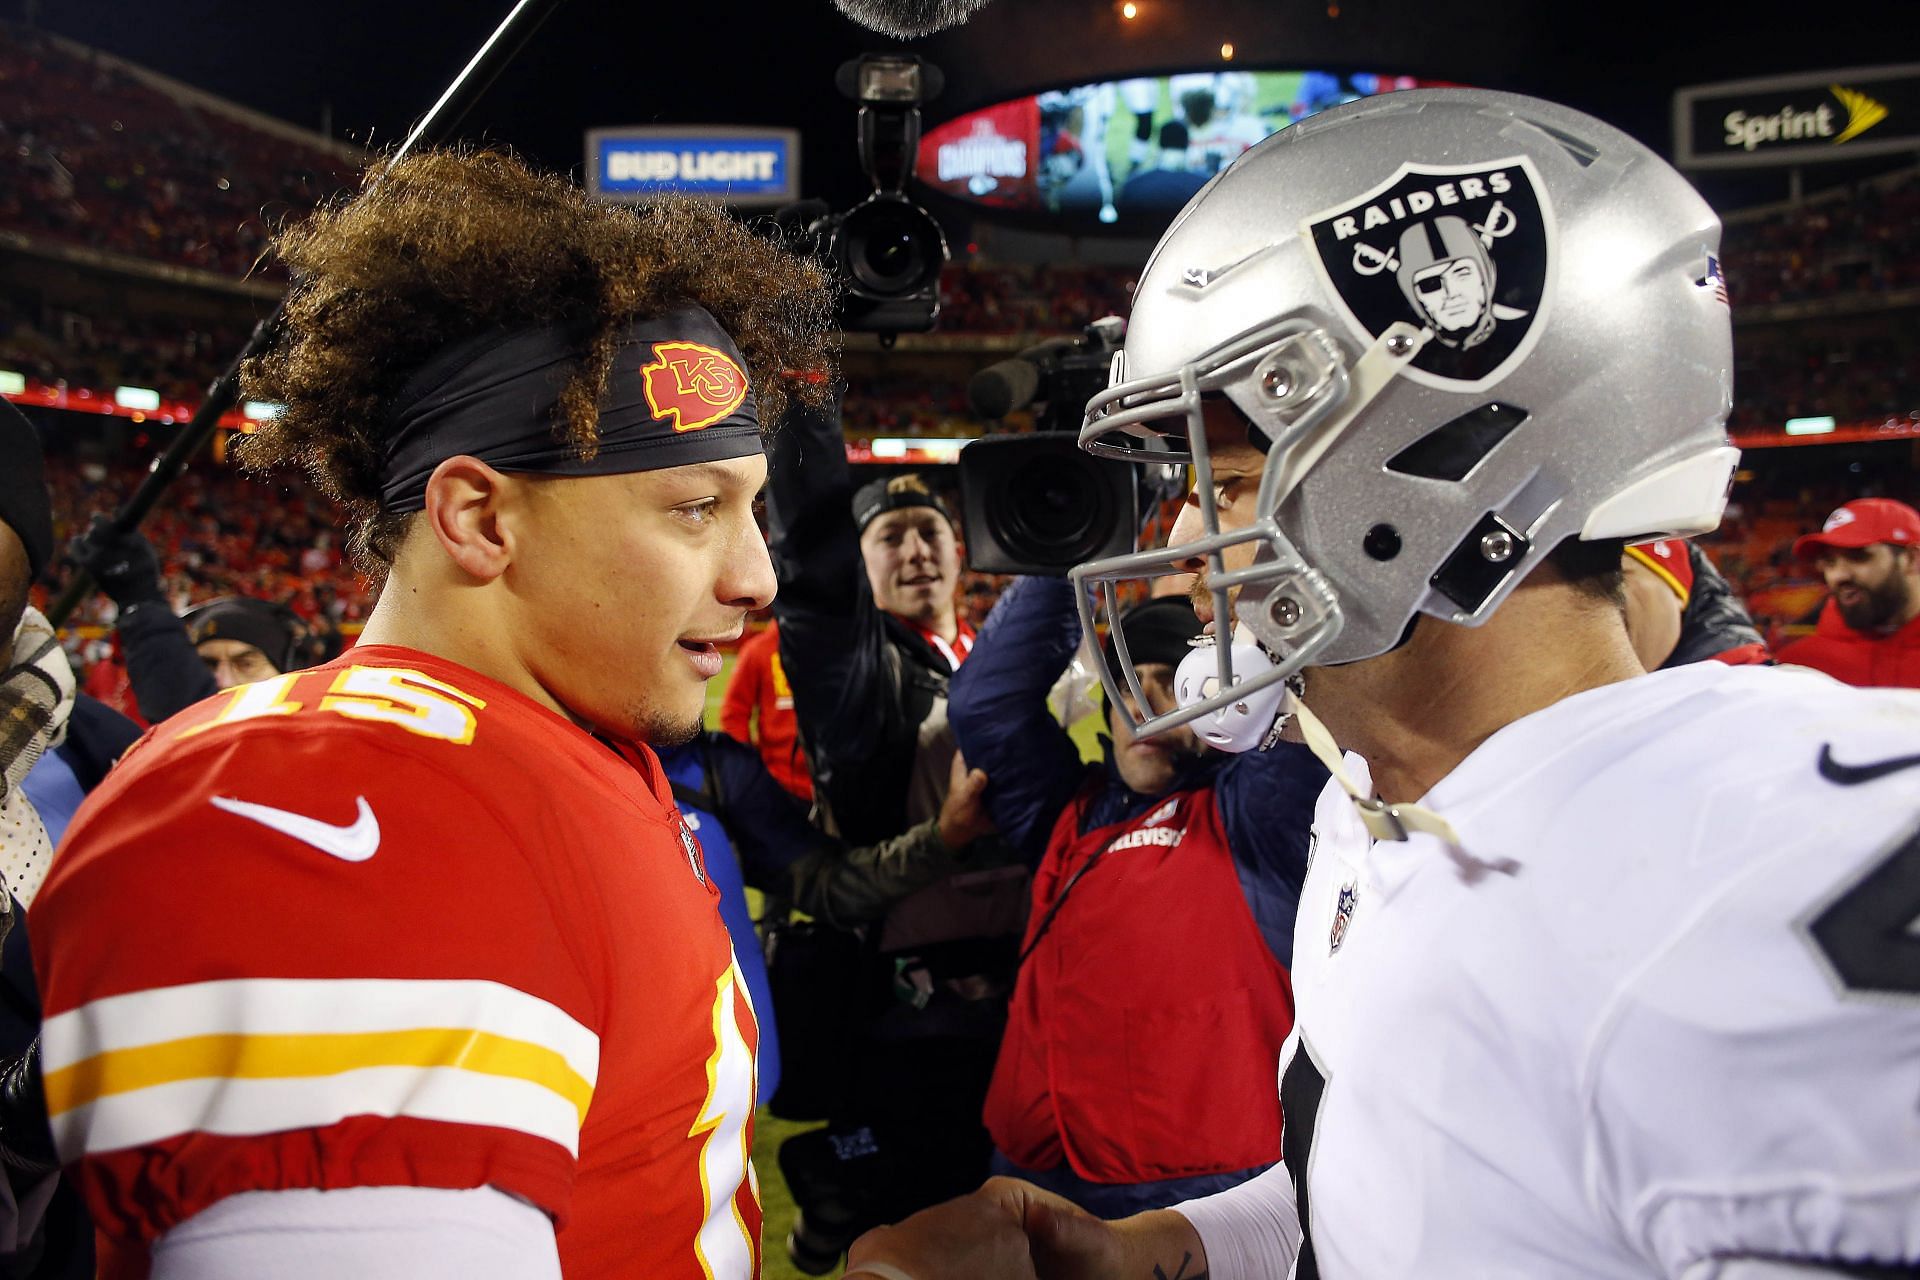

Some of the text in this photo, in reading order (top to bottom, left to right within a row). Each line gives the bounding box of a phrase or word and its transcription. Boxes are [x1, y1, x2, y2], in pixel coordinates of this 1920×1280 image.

[1724, 104, 1834, 150] Sprint
[608, 151, 777, 181] BUD LIGHT
[1332, 172, 1512, 240] RAIDERS
[670, 357, 736, 405] KC
[175, 665, 487, 746] 15
